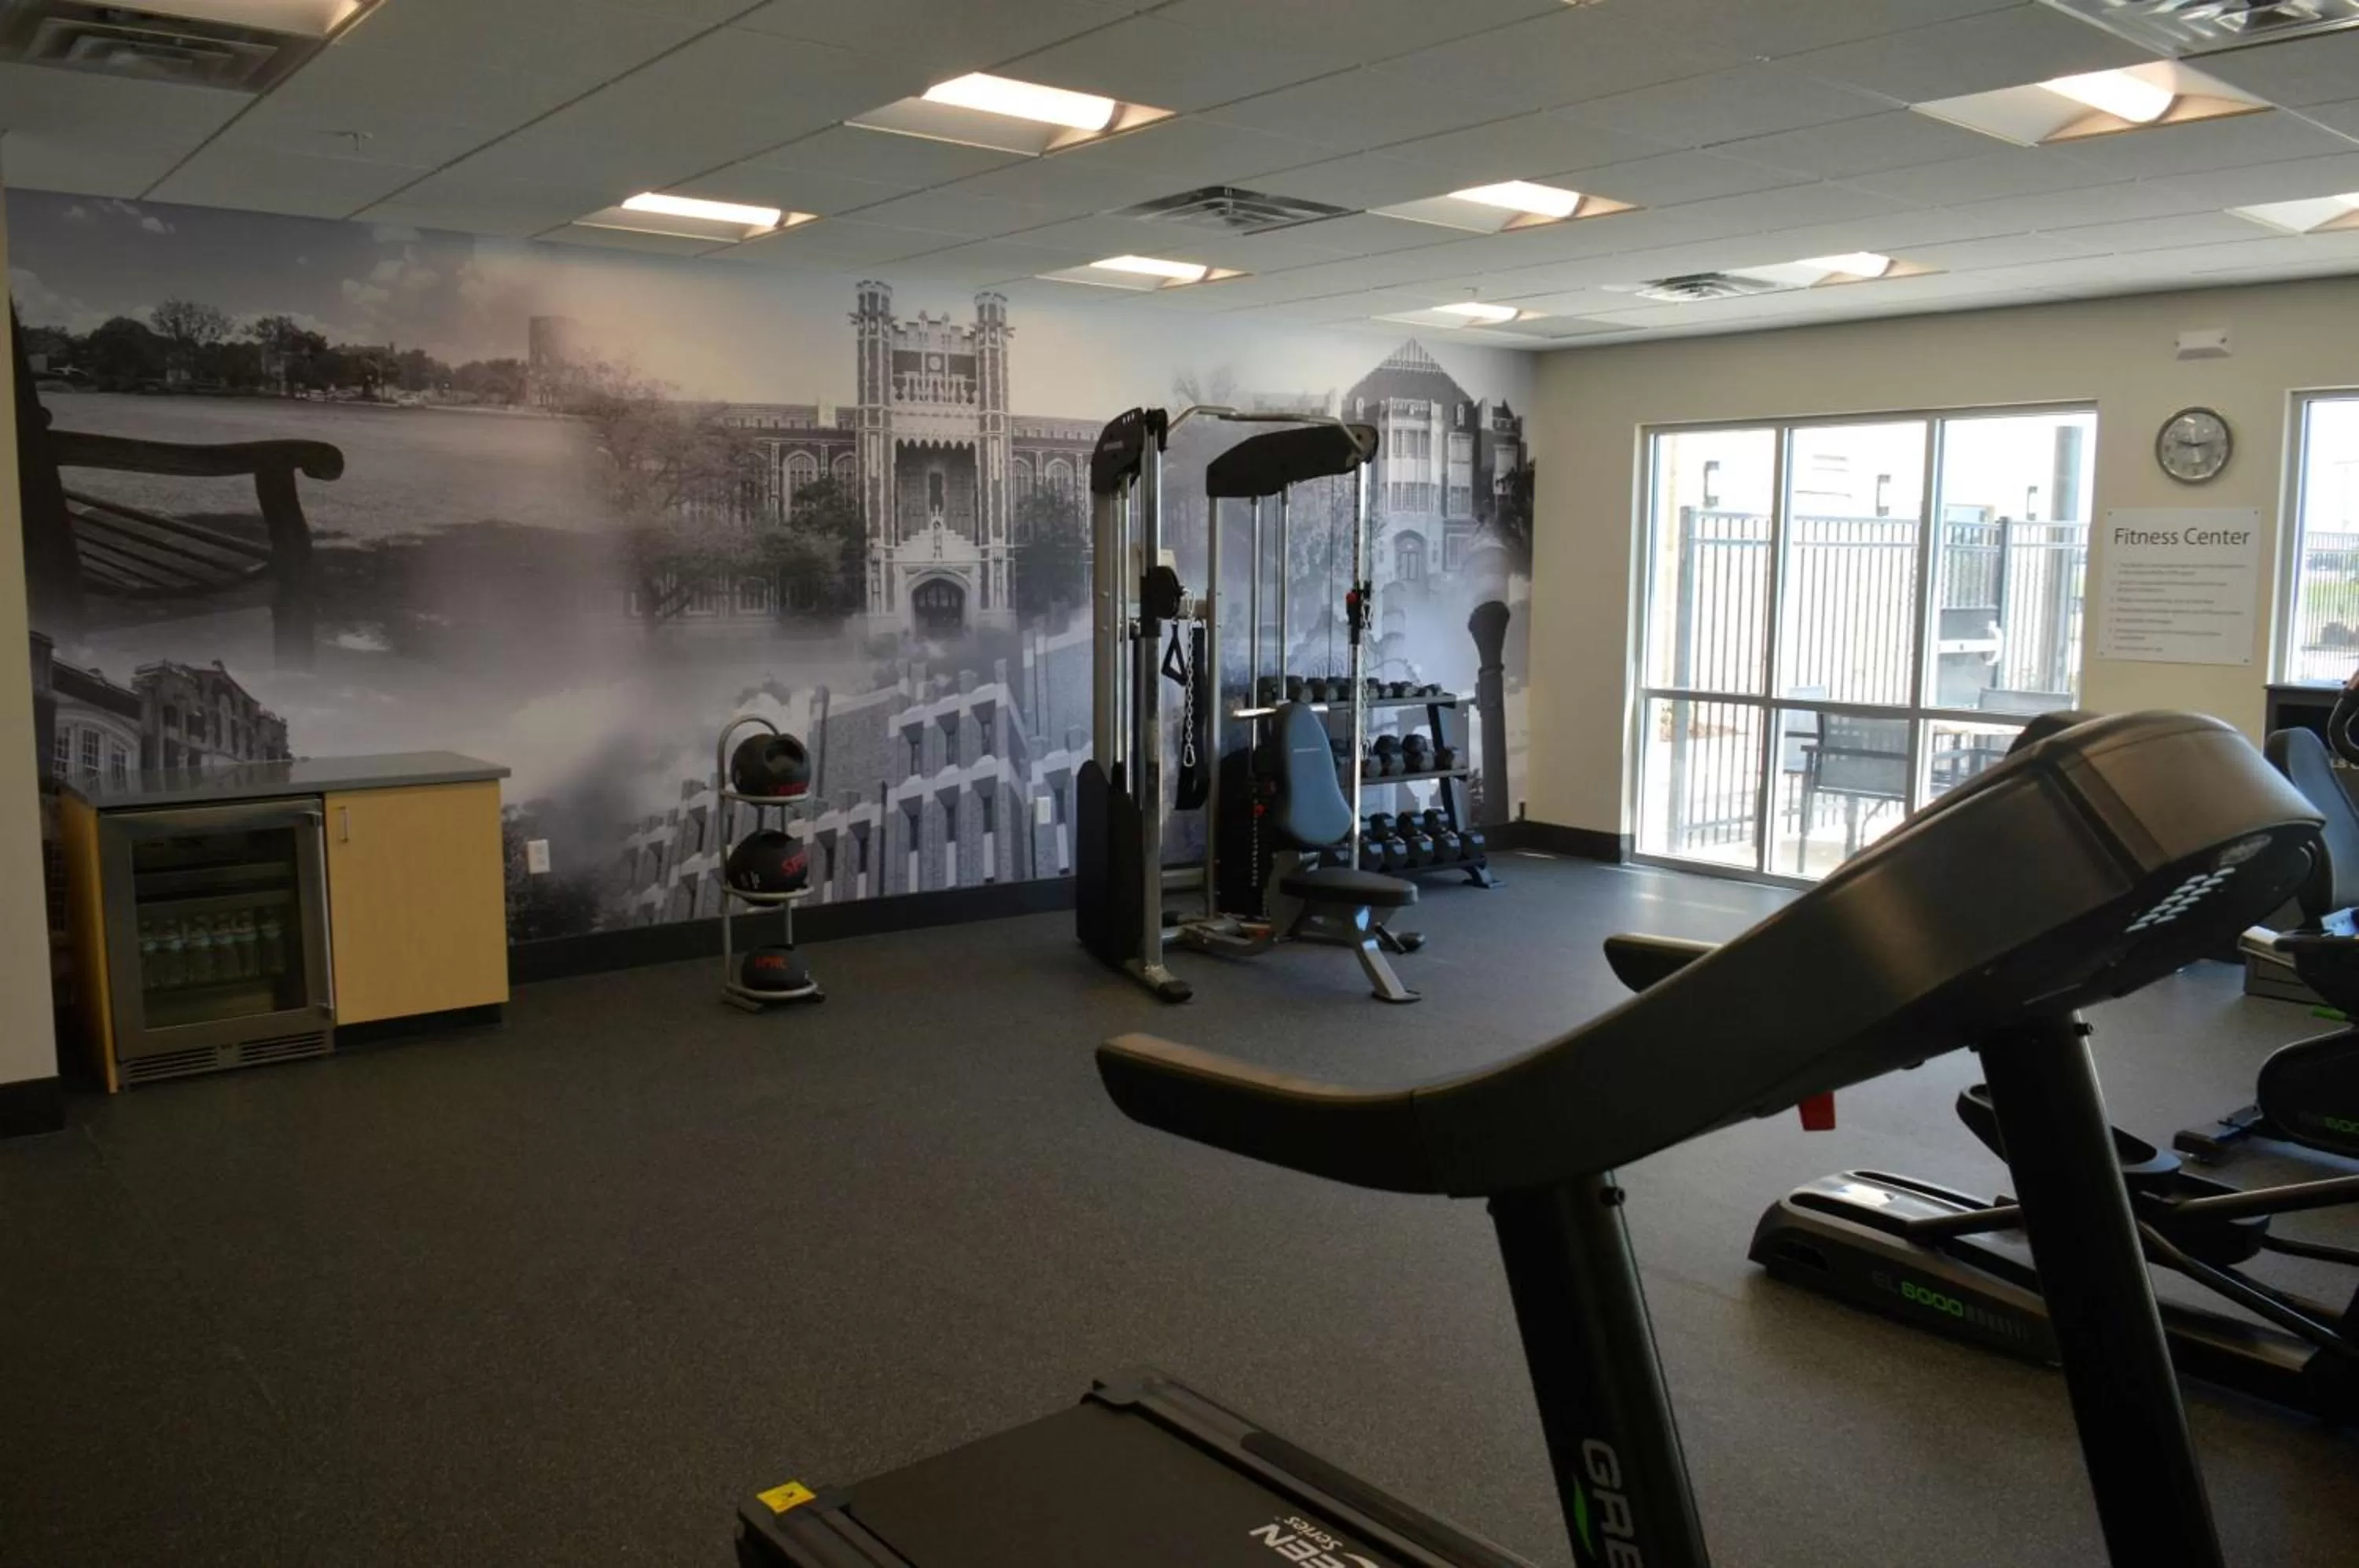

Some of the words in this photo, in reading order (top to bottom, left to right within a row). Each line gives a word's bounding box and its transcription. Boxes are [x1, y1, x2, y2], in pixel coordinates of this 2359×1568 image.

[2114, 528, 2179, 546] Fitness
[2183, 528, 2251, 546] Center
[1283, 1515, 1344, 1551] Series
